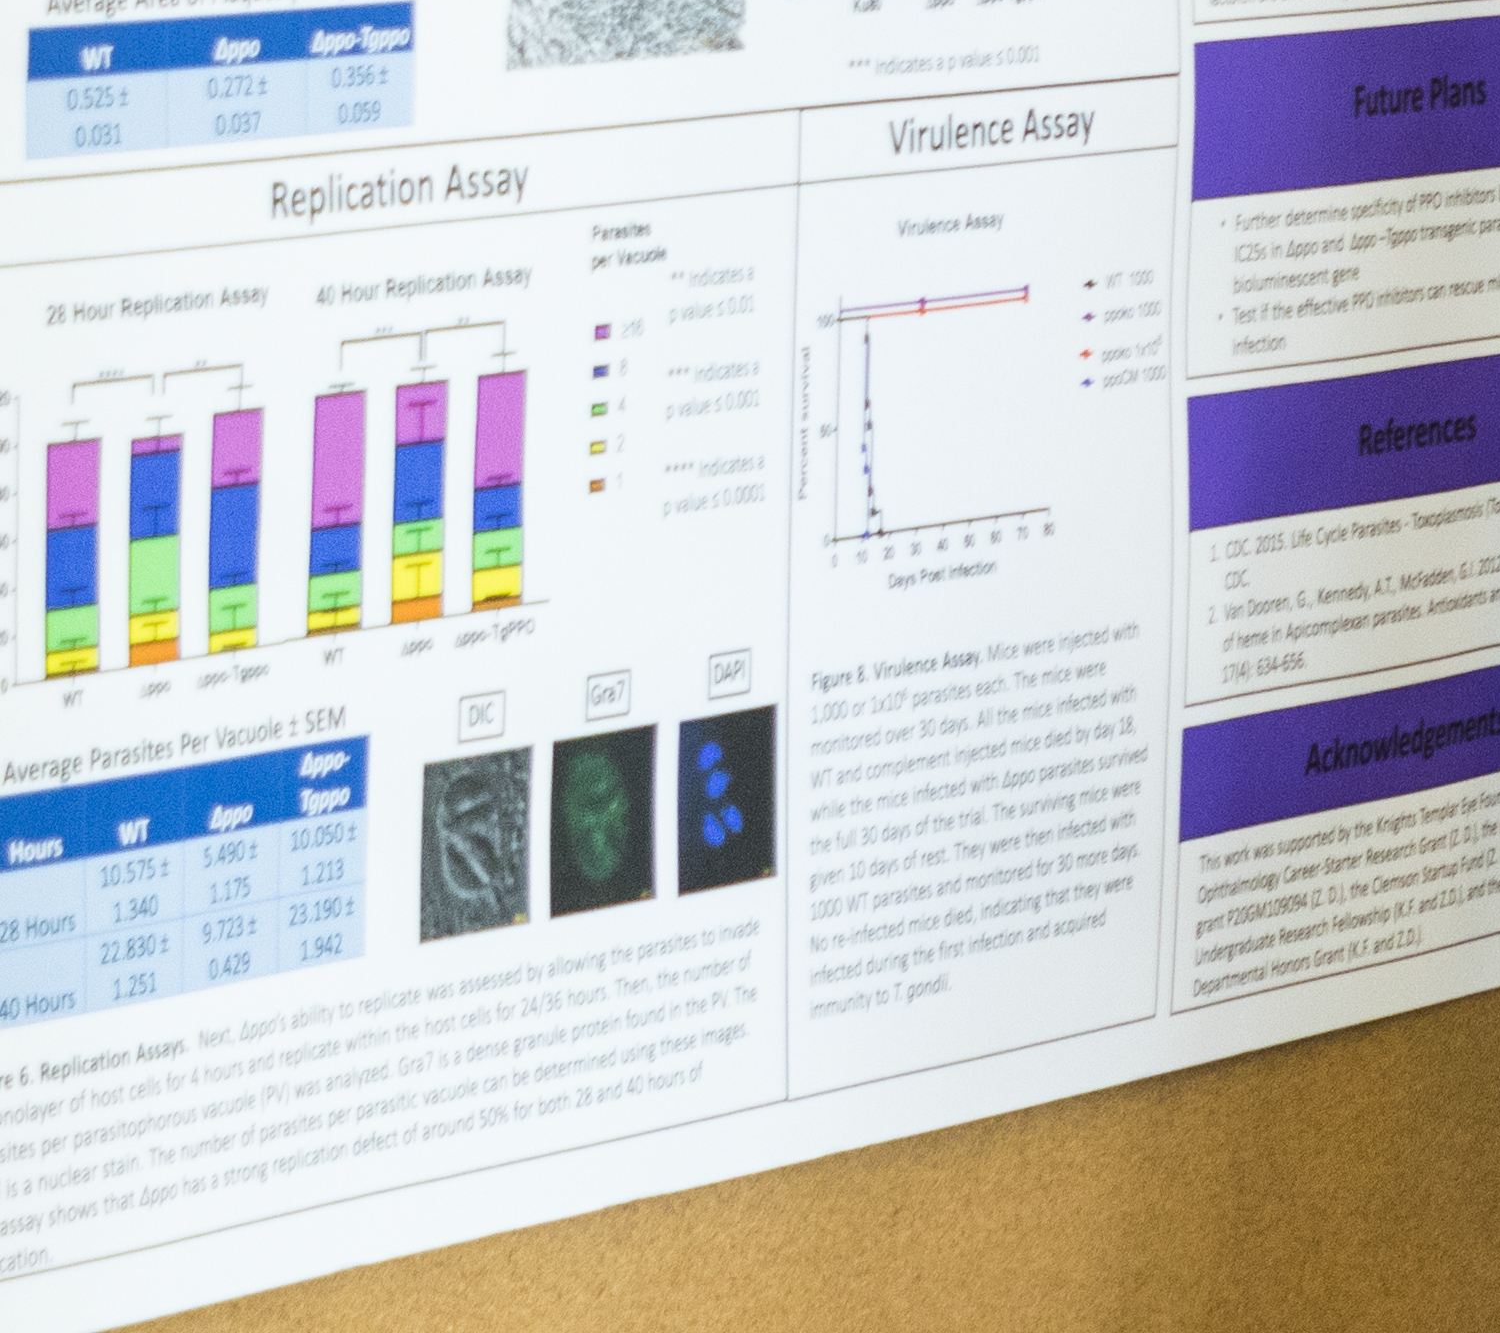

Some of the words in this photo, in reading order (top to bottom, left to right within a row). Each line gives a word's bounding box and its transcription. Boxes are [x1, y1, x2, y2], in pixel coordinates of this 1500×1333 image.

[79, 44, 114, 72] WT
[65, 85, 115, 112] 0.525
[207, 74, 252, 100] 0.272
[330, 64, 376, 90] 0.356
[1353, 84, 1426, 118] Future
[1428, 73, 1488, 110] Plans
[72, 122, 122, 150] 0.031
[213, 109, 262, 138] 0.037
[336, 99, 382, 126] 0.059
[888, 114, 1015, 155] Virulence
[1022, 107, 1095, 145] Assay
[270, 174, 434, 223] Replication
[444, 163, 529, 203] Assay
[591, 223, 651, 242] Parasites
[897, 218, 962, 237] Virulence
[964, 213, 1004, 230] Assay
[592, 247, 611, 271] per
[617, 247, 668, 266] Vacuole
[45, 303, 67, 327] 28
[71, 302, 116, 323] Hour
[119, 292, 213, 320] Replication
[218, 285, 269, 313] Assay
[315, 285, 335, 306] 40
[339, 283, 381, 304] Hour
[384, 272, 476, 300] Replication
[481, 266, 532, 294] Assay
[1358, 413, 1478, 456] References
[887, 572, 918, 590] Days
[919, 567, 947, 584] Post
[948, 561, 997, 579] Infection
[810, 670, 854, 694] Figure
[873, 657, 939, 681] Virulence
[942, 649, 986, 672] Assay.
[986, 642, 1020, 662] Mice
[1022, 638, 1056, 657] were
[1058, 626, 1110, 653] injected
[1111, 621, 1140, 643] with
[587, 678, 626, 707] Gra7
[713, 658, 746, 686] DAPI
[4, 760, 83, 785] Average
[90, 735, 173, 771] Parasites
[179, 732, 210, 755] Per
[216, 717, 283, 747] Vacuole
[304, 705, 346, 735] SEM
[7, 837, 64, 865] Hours
[117, 817, 150, 847] WT
[301, 785, 350, 814] Tgppo
[101, 857, 155, 888] 10.575
[203, 839, 245, 869] 5.490
[291, 822, 343, 852] 10.050
[0, 918, 20, 945] 28
[23, 914, 77, 939] Hours
[113, 893, 159, 925] 1.340
[209, 874, 252, 906] 1.175
[301, 856, 345, 888] 1.213
[99, 933, 157, 967] 22.830
[201, 914, 245, 946] 9.723
[288, 895, 343, 928] 23.190
[0, 996, 20, 1021] 40
[23, 991, 77, 1017] Hours
[112, 970, 158, 1002] 1.251
[207, 950, 252, 981] 0.429
[300, 931, 343, 963] 1.942
[38, 1050, 130, 1083] Replication
[134, 1039, 190, 1063] Assays.
